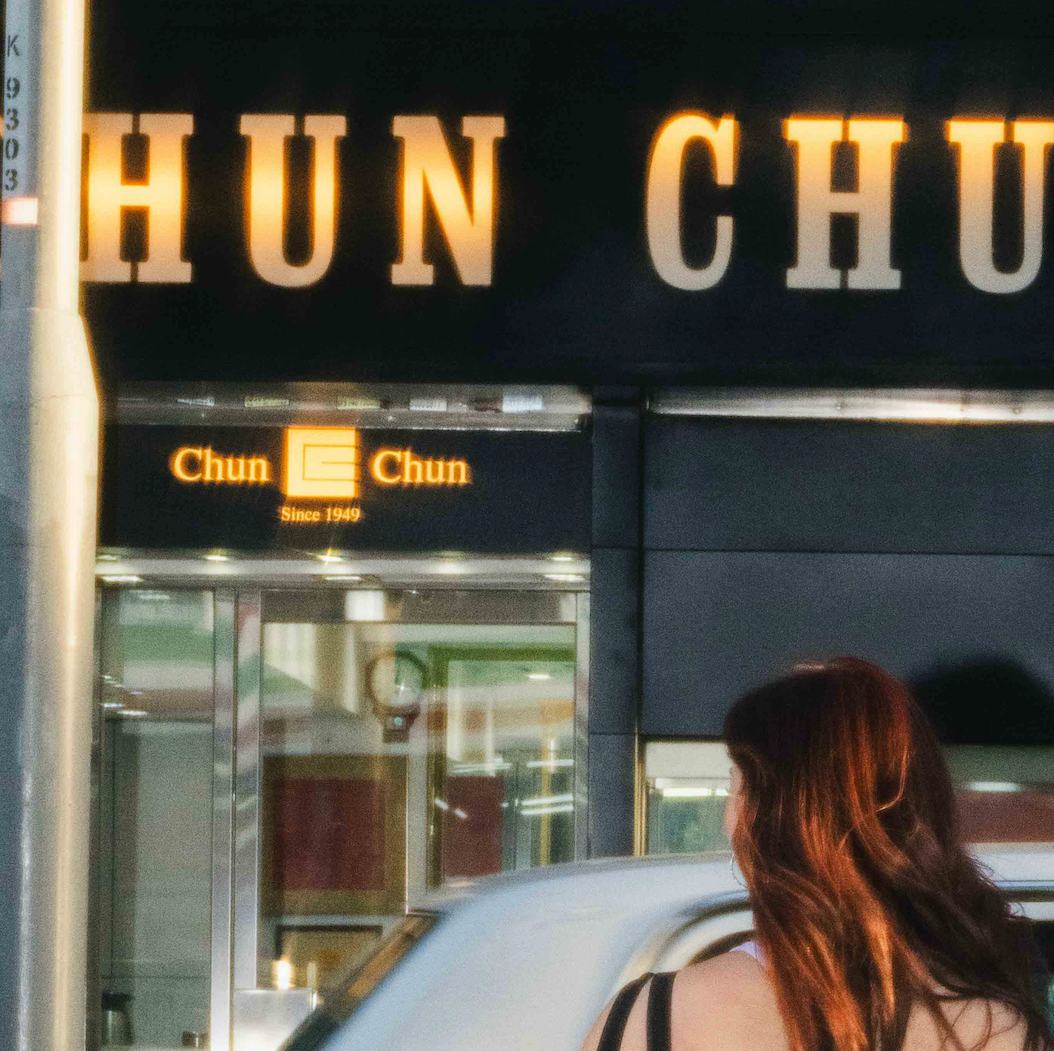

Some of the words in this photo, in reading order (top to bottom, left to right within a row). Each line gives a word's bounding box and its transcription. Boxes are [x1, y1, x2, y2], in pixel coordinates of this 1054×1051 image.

[81, 113, 506, 287] HUN
[172, 446, 272, 483] Chun
[372, 447, 471, 485] Chun
[280, 506, 321, 522] Since
[325, 506, 361, 522] 1949
